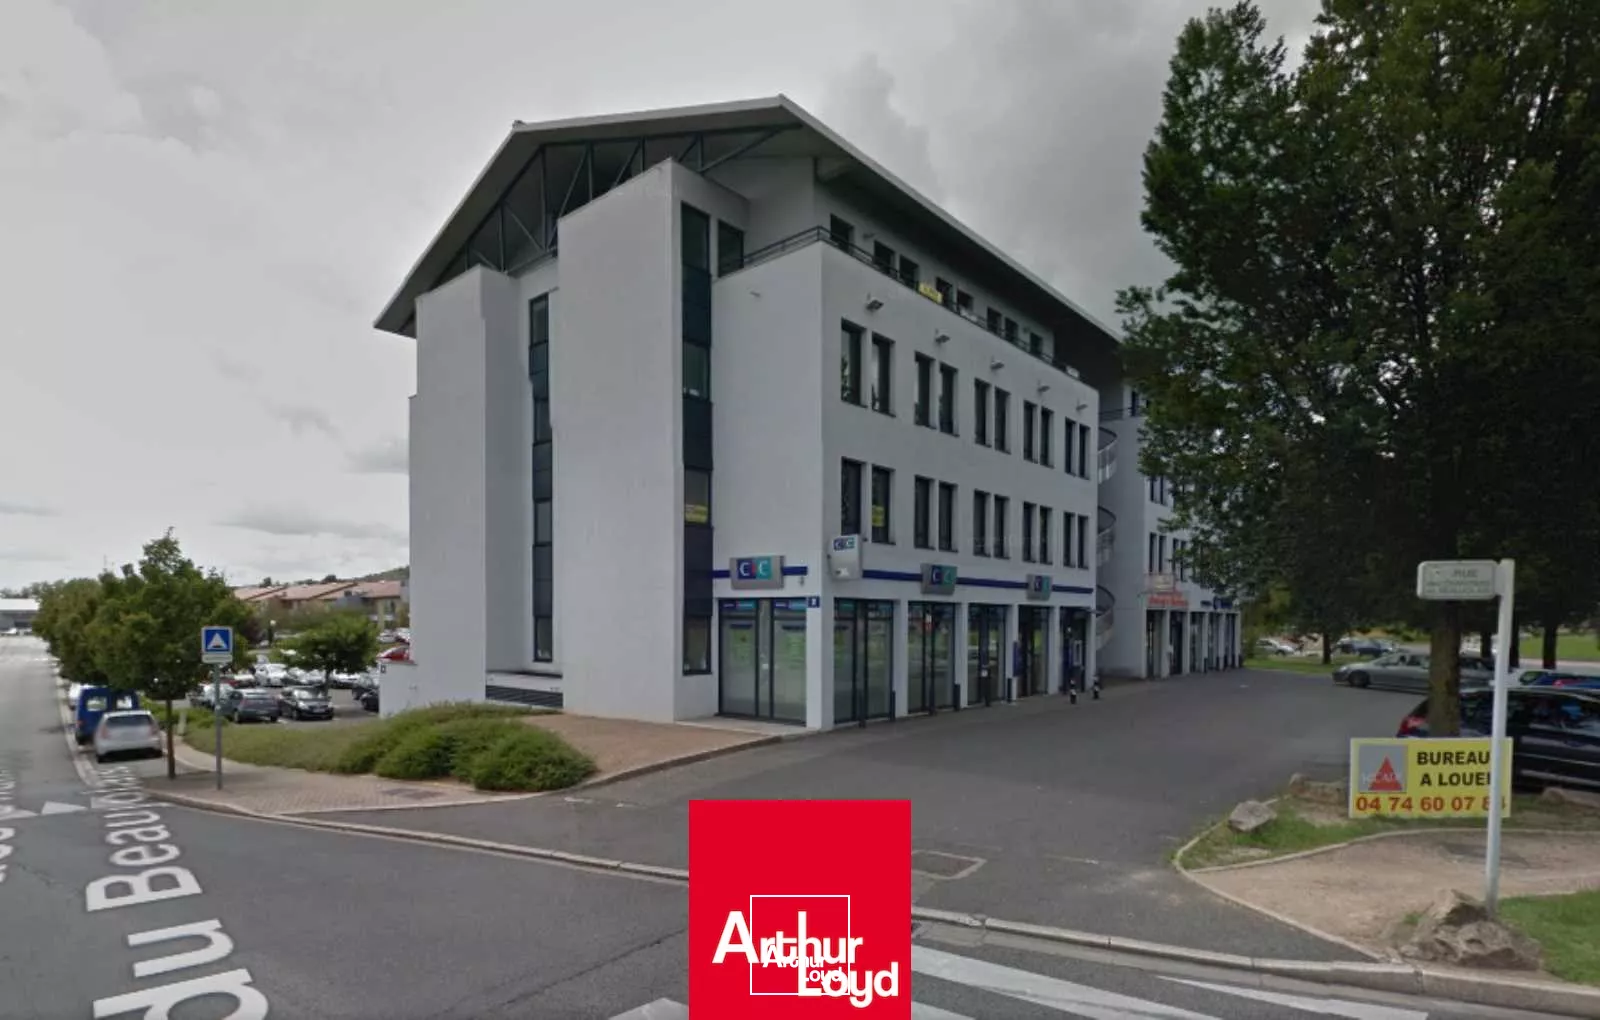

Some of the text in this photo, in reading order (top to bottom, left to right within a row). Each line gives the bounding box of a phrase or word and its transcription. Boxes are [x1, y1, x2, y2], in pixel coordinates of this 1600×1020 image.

[1417, 751, 1490, 765] BUREAU
[1420, 773, 1433, 786] A
[1355, 796, 1381, 812] 04
[1388, 796, 1413, 812] 74
[1420, 796, 1445, 812] 60
[1451, 796, 1475, 812] 07
